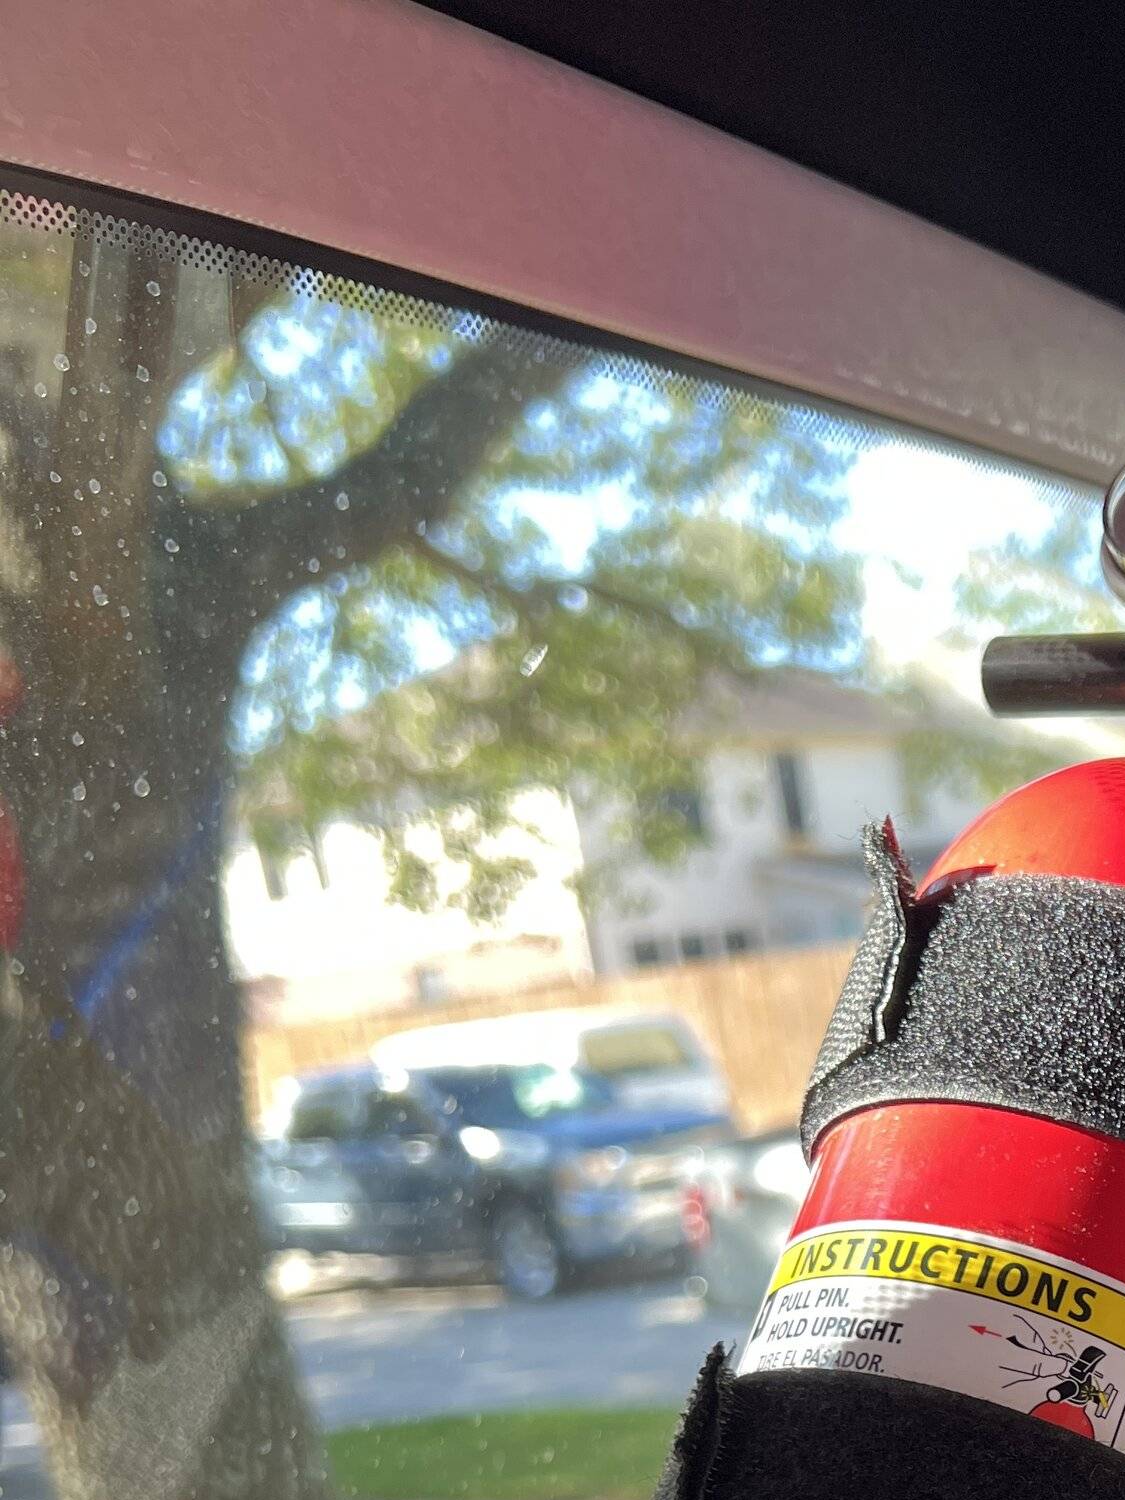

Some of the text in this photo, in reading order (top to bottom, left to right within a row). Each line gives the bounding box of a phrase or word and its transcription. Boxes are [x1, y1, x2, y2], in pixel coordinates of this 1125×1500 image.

[790, 1237, 1098, 1323] INSTRUCTIONS
[778, 1287, 851, 1315] PULL PIN.
[766, 1317, 808, 1344] HOLD
[811, 1315, 905, 1345] UPRIGHT.
[782, 1349, 797, 1367] EL
[802, 1348, 886, 1374] PASADOR.
